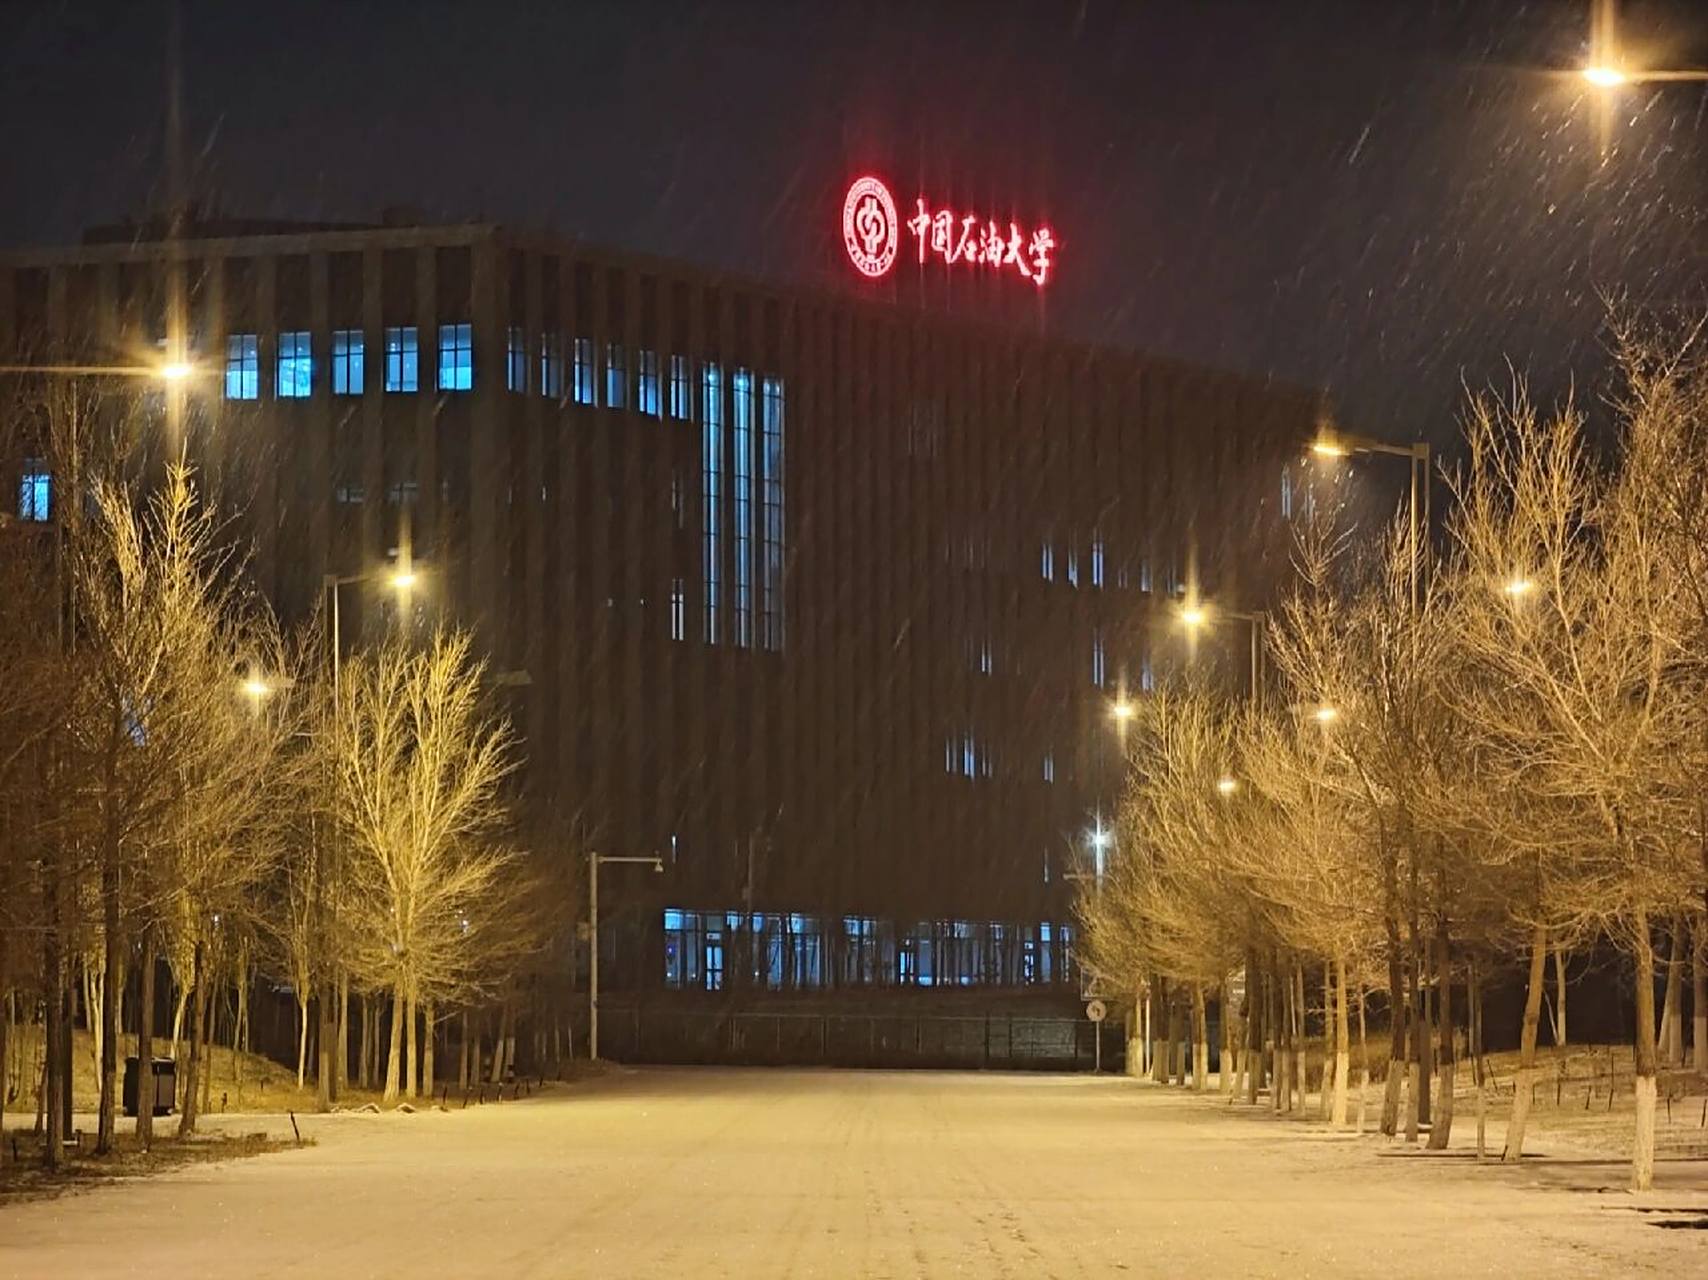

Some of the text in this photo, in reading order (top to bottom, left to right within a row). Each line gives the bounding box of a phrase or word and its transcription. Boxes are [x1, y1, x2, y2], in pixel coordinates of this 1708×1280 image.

[906, 198, 1055, 286] 中国石油大学
